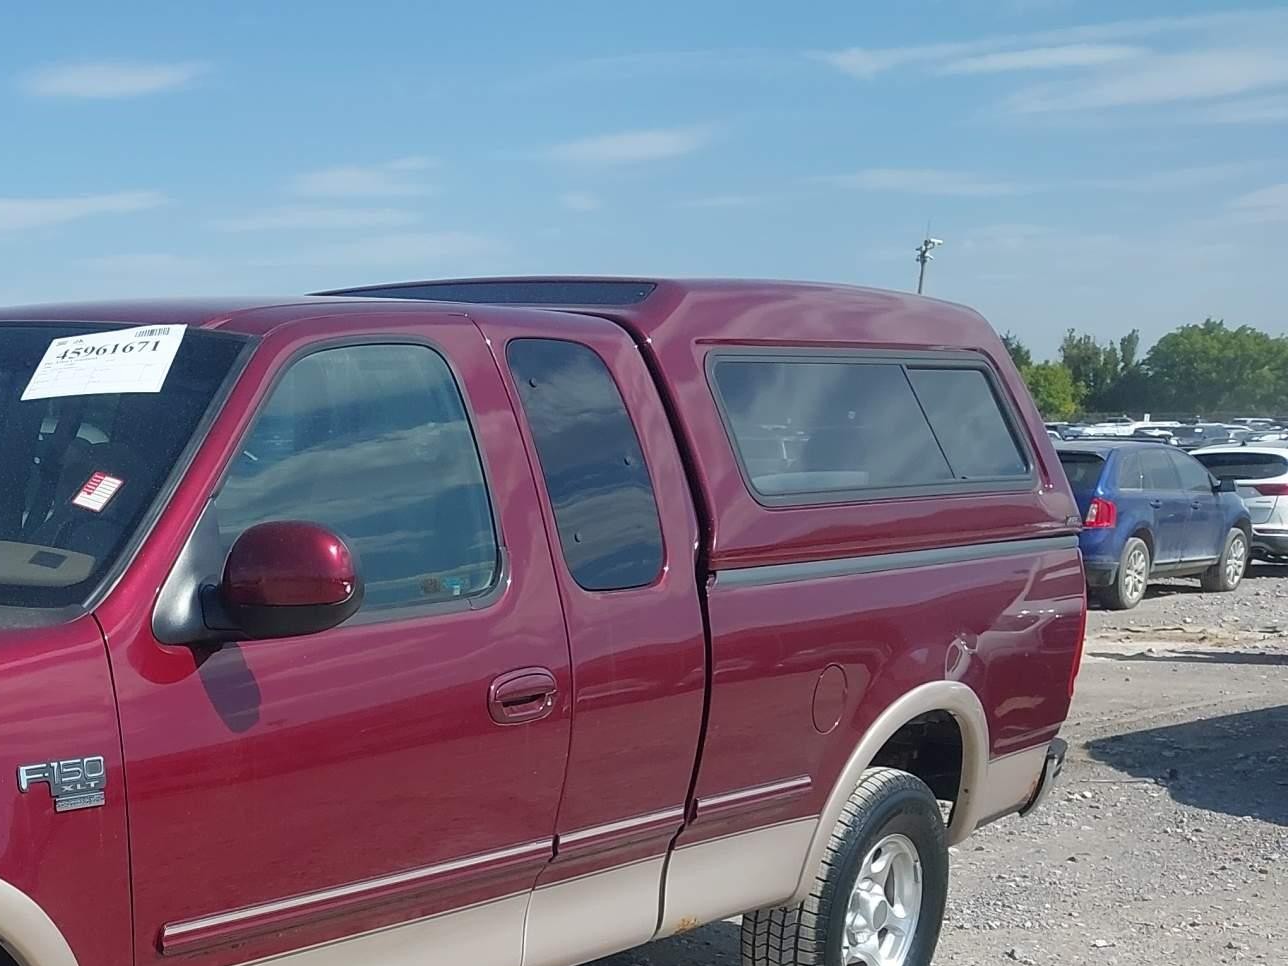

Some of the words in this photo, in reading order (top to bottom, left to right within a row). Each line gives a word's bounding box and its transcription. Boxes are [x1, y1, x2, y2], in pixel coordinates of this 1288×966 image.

[56, 340, 160, 360] 45961671
[18, 756, 104, 790] F-150
[61, 781, 99, 792] XLT
